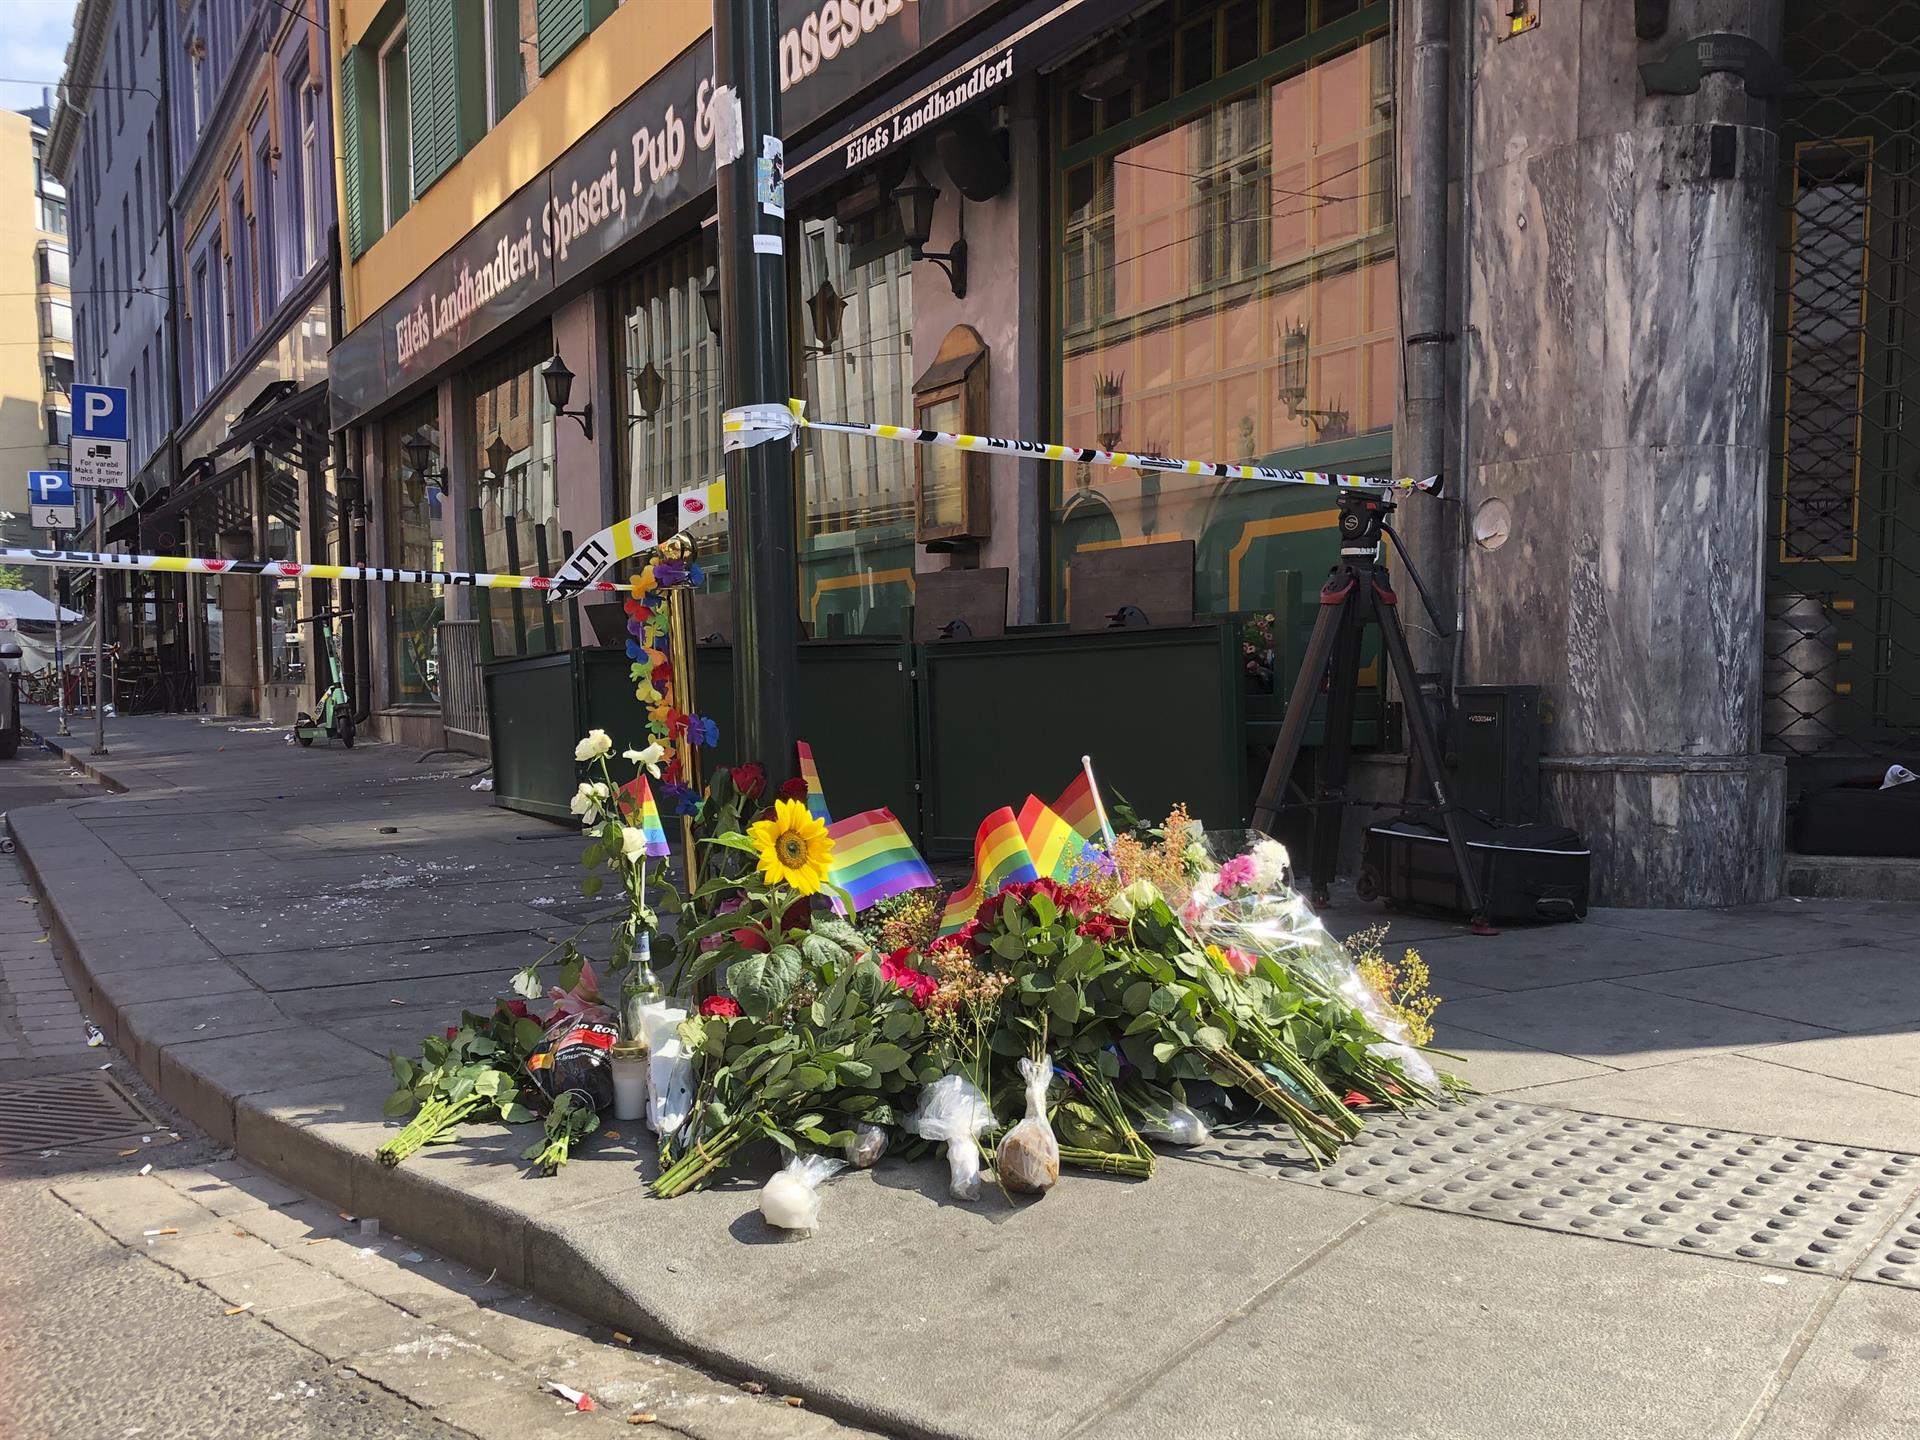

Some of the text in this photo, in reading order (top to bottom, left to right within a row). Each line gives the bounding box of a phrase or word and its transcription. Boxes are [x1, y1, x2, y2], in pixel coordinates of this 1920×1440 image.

[845, 48, 1013, 170] Eilefs Landhandleri
[395, 304, 430, 365] Eilefs
[430, 217, 539, 339] Landhandleri,
[542, 149, 626, 262] Spiseri,
[631, 104, 686, 197] Pub
[84, 391, 114, 431] P
[80, 458, 92, 466] For
[39, 475, 63, 500] P
